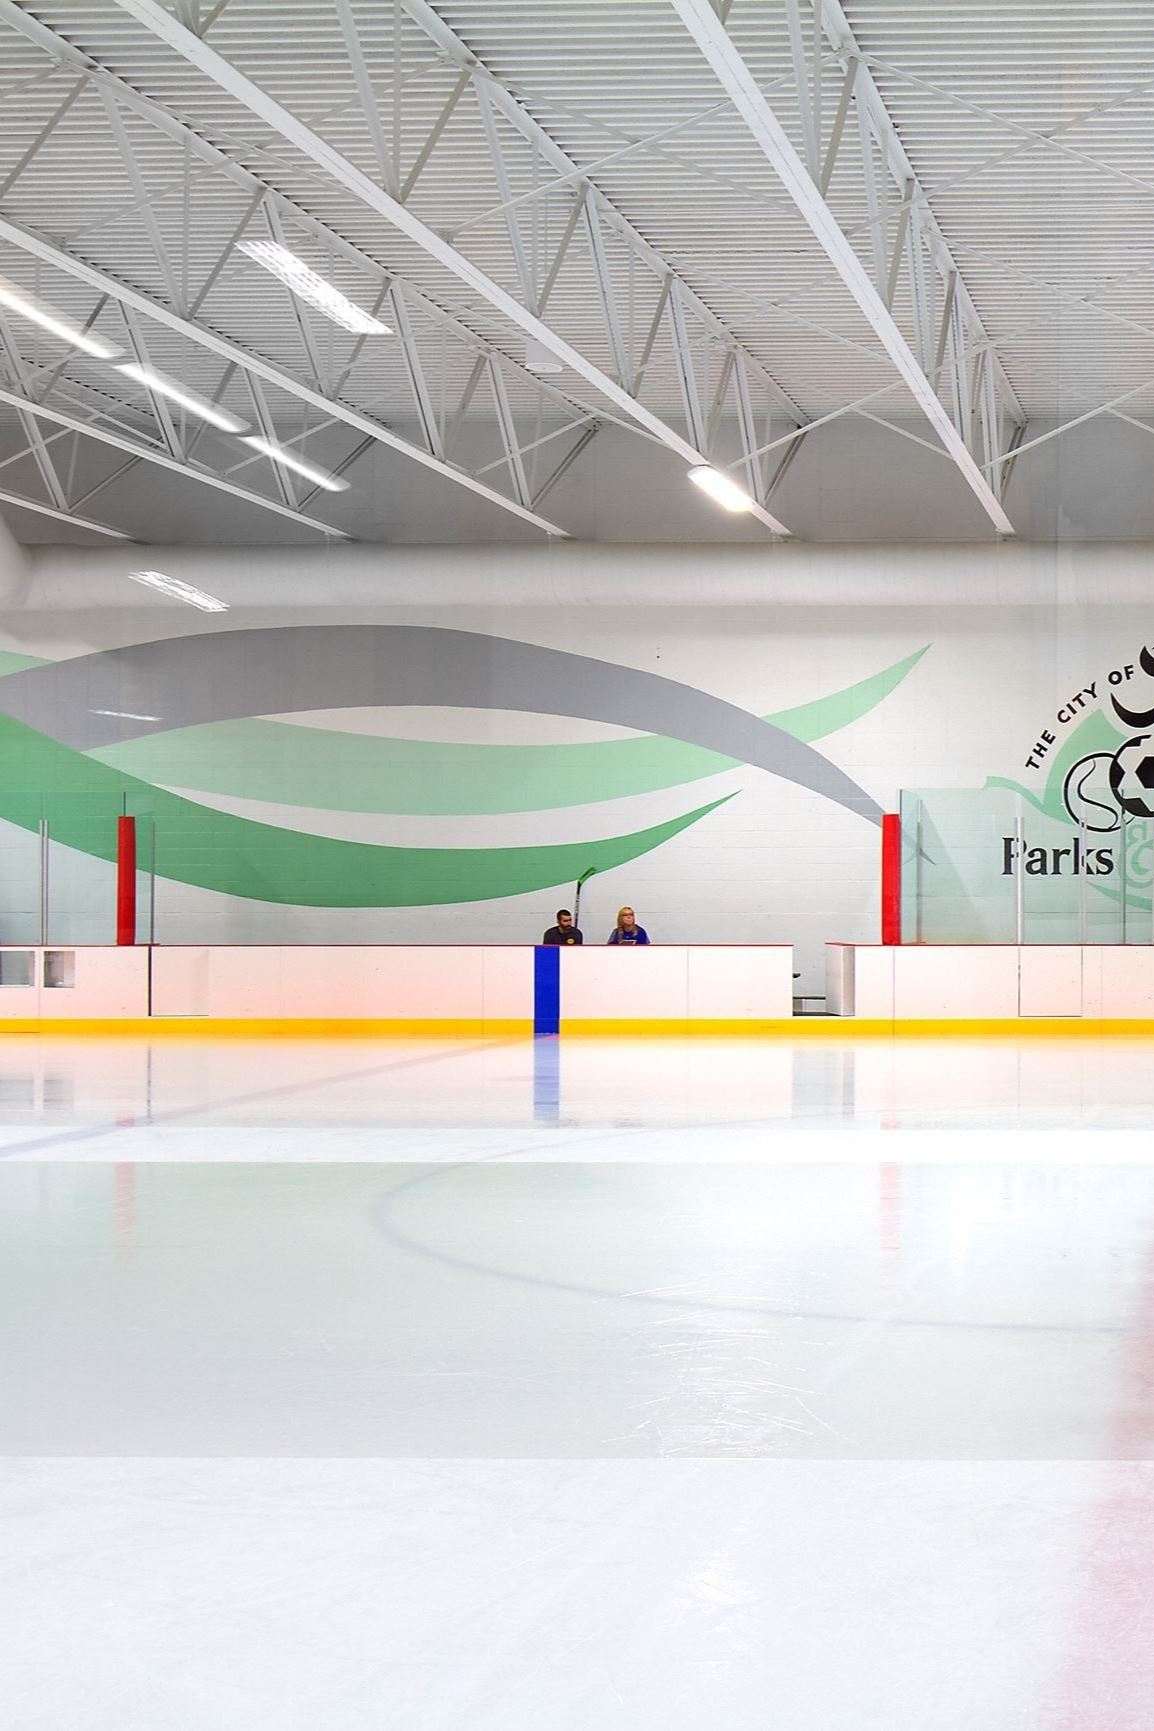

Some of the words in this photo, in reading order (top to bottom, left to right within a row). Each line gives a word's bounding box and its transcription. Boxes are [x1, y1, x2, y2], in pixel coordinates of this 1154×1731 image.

[1025, 729, 1056, 770] THE
[1056, 681, 1098, 724] CITY
[1107, 664, 1135, 686] OF
[1001, 837, 1115, 876] Parks
